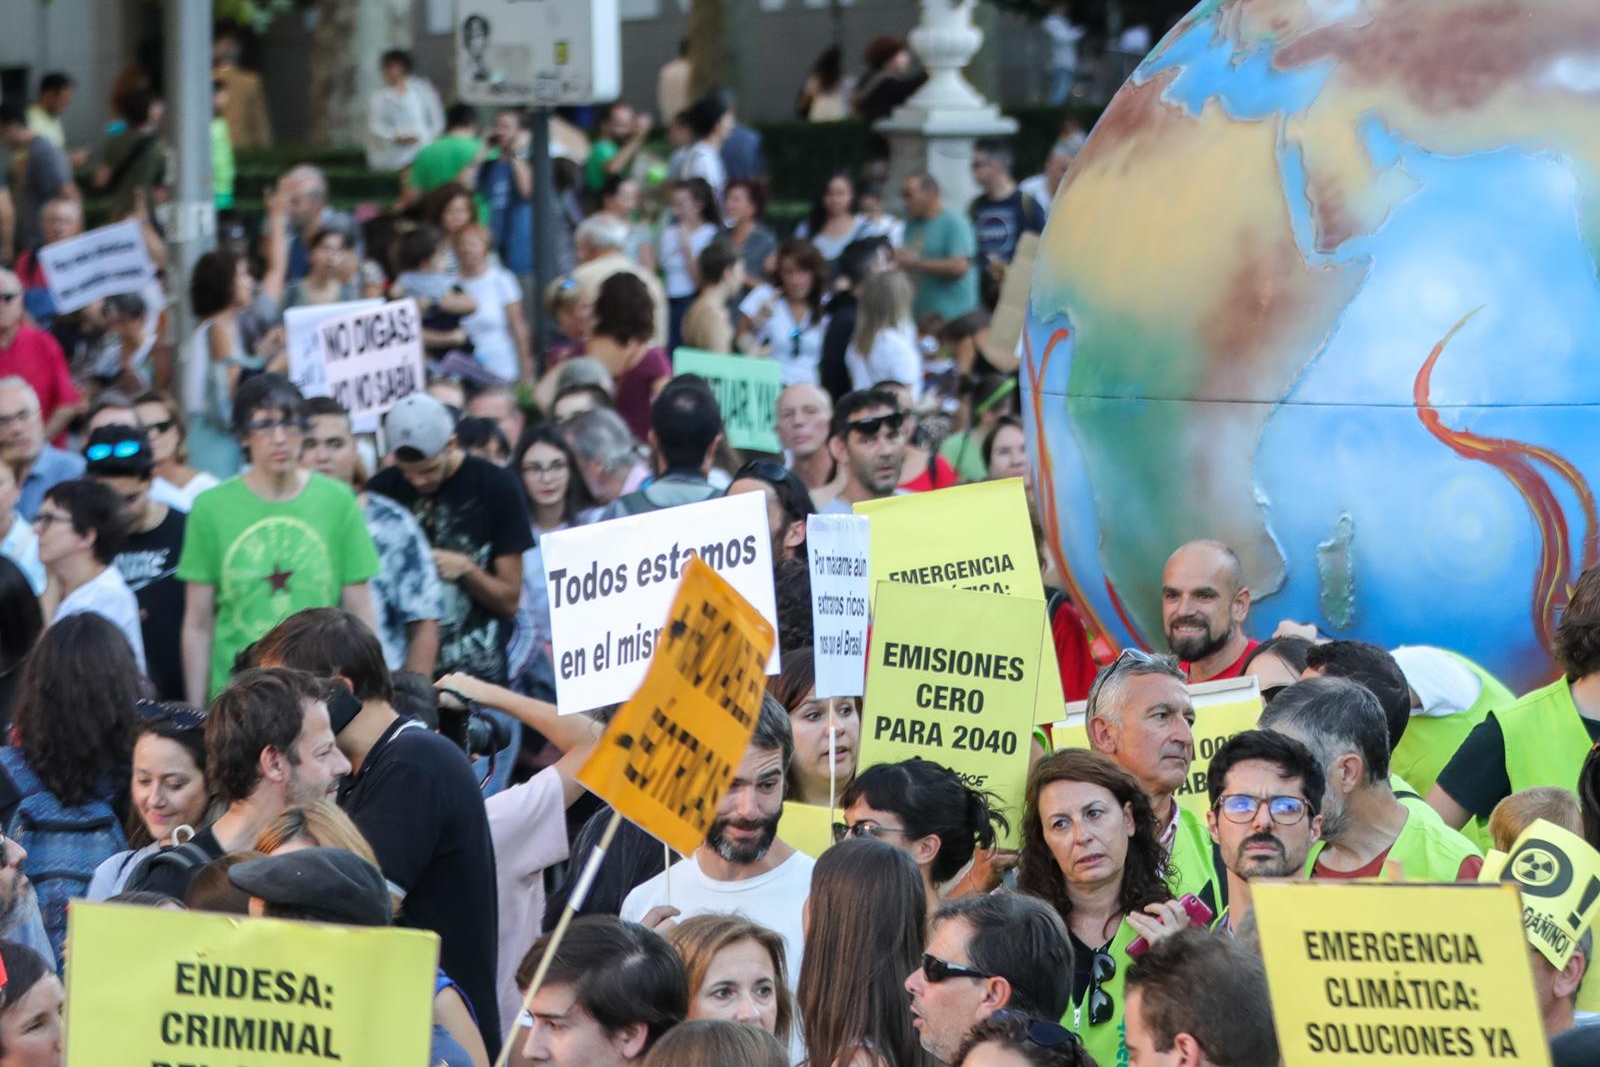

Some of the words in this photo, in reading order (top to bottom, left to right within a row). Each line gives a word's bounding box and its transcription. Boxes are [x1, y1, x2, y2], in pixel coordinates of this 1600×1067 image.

[323, 323, 352, 362] NO
[549, 561, 628, 608] Todos
[636, 534, 757, 587] estamos
[889, 554, 1015, 585] EMERGENCIA
[560, 638, 586, 681] en
[593, 631, 611, 671] el
[883, 642, 1025, 682] EMISIONES
[916, 683, 985, 714] CERO
[874, 716, 943, 747] PARA
[951, 725, 1018, 756] 2040
[1303, 930, 1483, 965] EMERGENCIA
[175, 961, 334, 1010] ENDESA:
[1325, 970, 1481, 1012] CLIMÁTICA:
[161, 1011, 342, 1061] CRIMINAL
[1306, 1022, 1474, 1058] SOLUCIONES
[1480, 1027, 1519, 1060] YA
